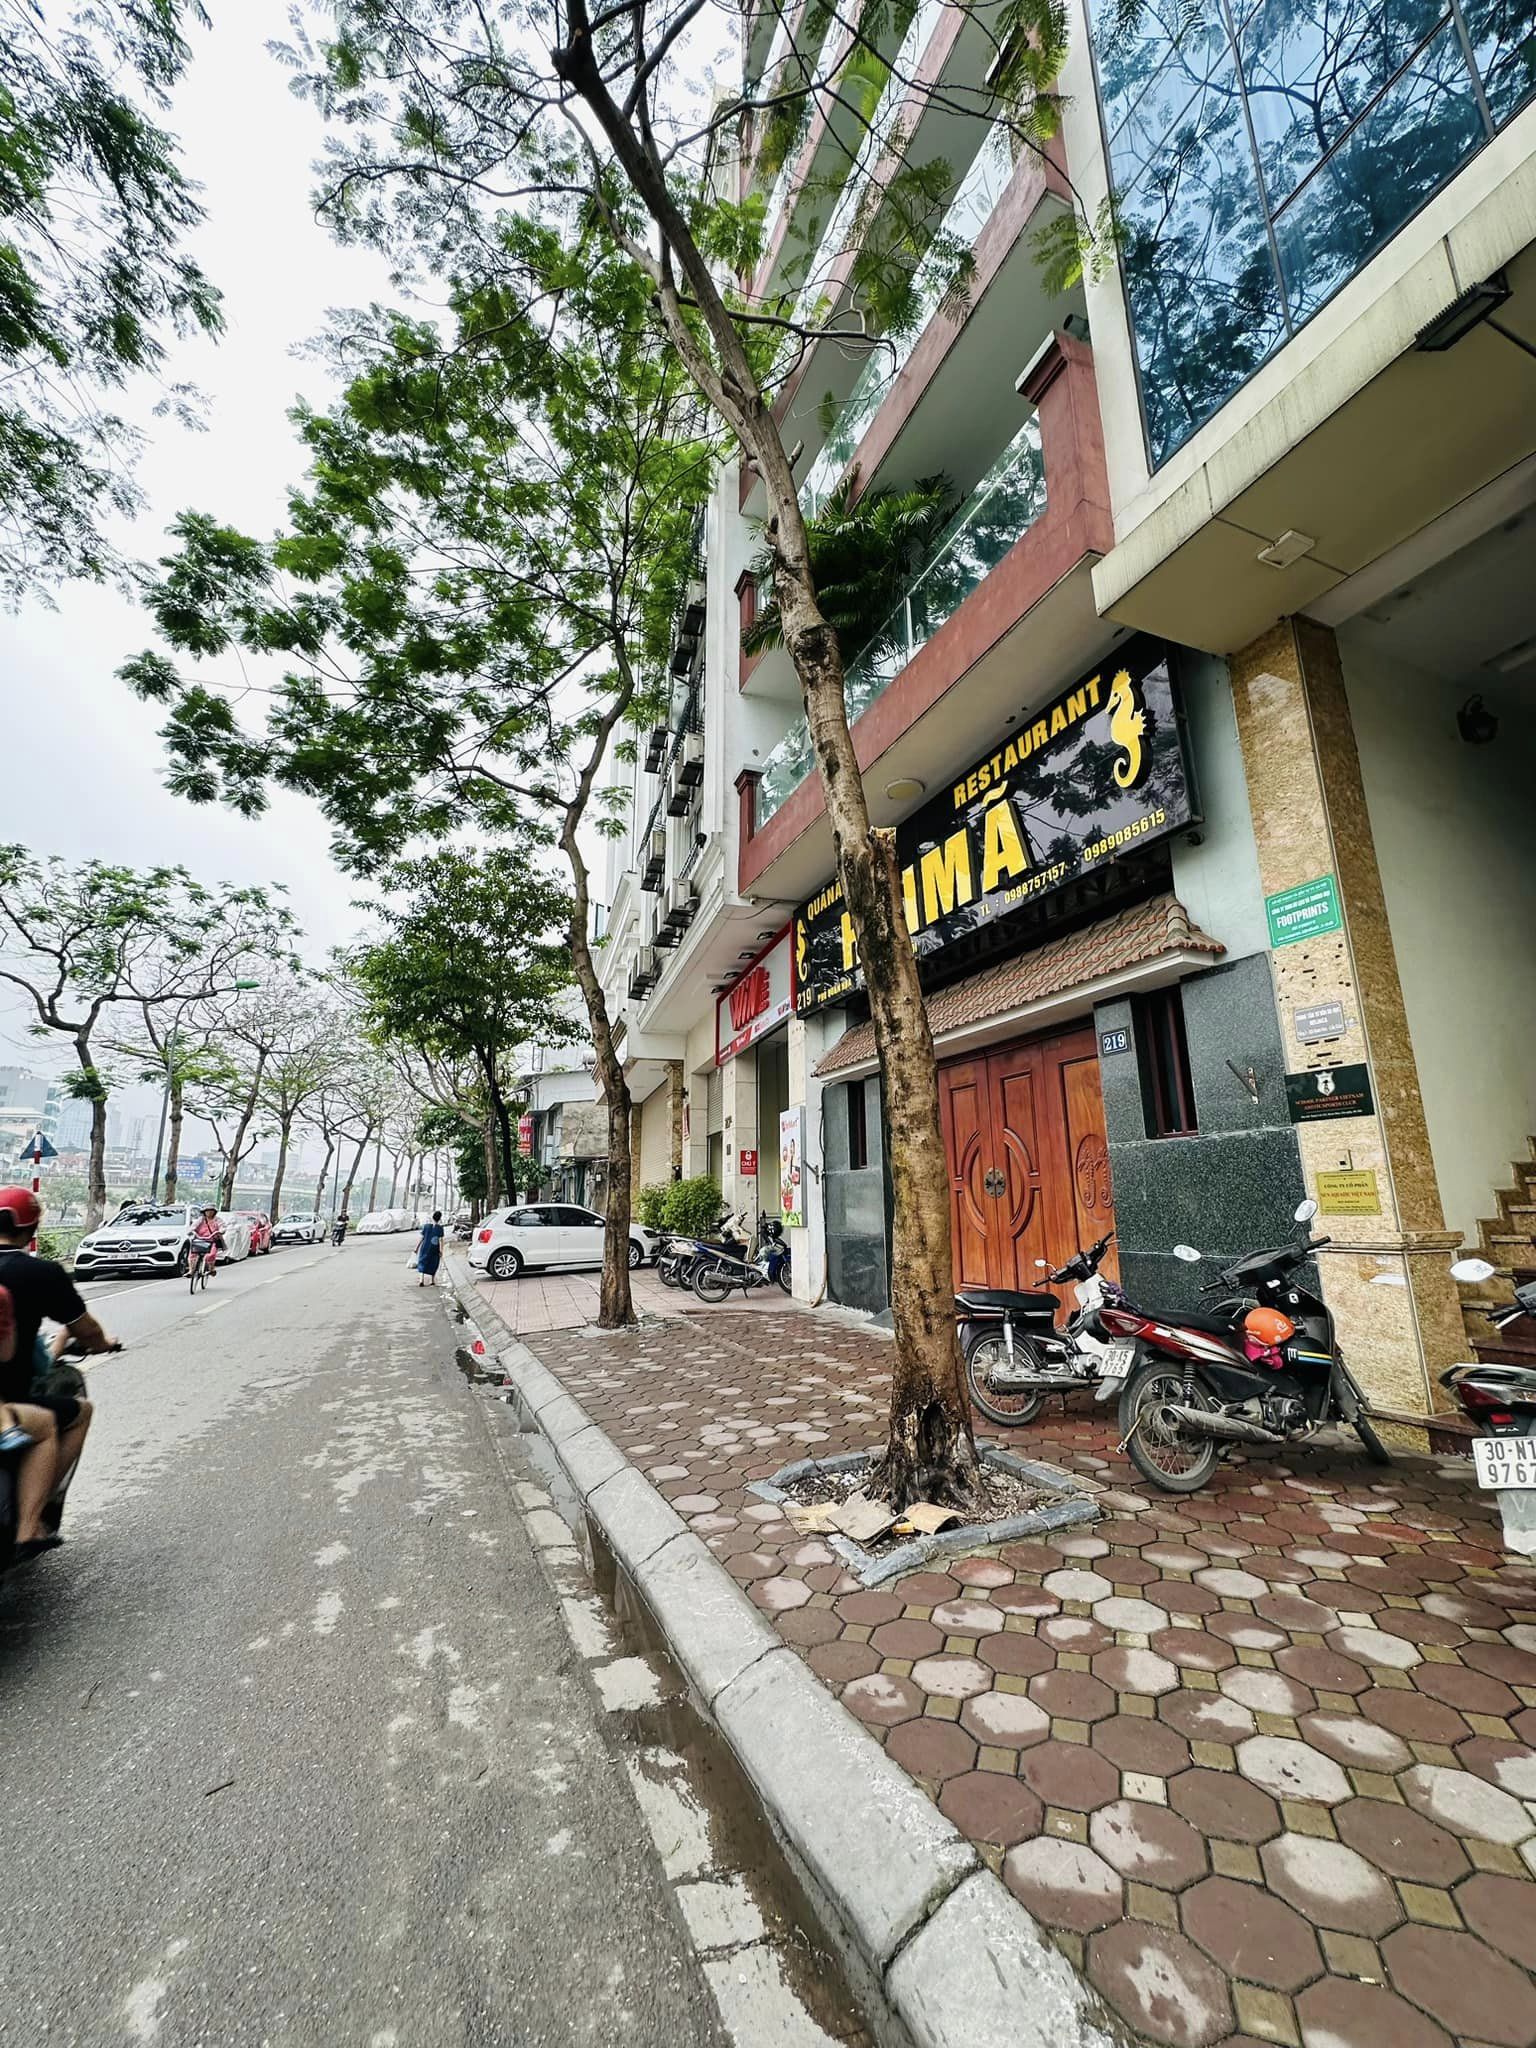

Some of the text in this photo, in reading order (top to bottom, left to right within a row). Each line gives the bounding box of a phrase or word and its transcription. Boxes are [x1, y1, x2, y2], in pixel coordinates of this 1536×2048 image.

[954, 675, 1101, 810] RESTAURANT
[1004, 861, 1066, 905] 0988757157
[1083, 807, 1167, 863] 0989085615
[841, 780, 1028, 972] HI MÃ
[1276, 901, 1329, 928] FOOTPRINTS
[797, 987, 812, 1010] 219
[1104, 1033, 1125, 1051] 219
[1484, 1440, 1536, 1461] 30-N1
[1487, 1463, 1536, 1483] 9767
